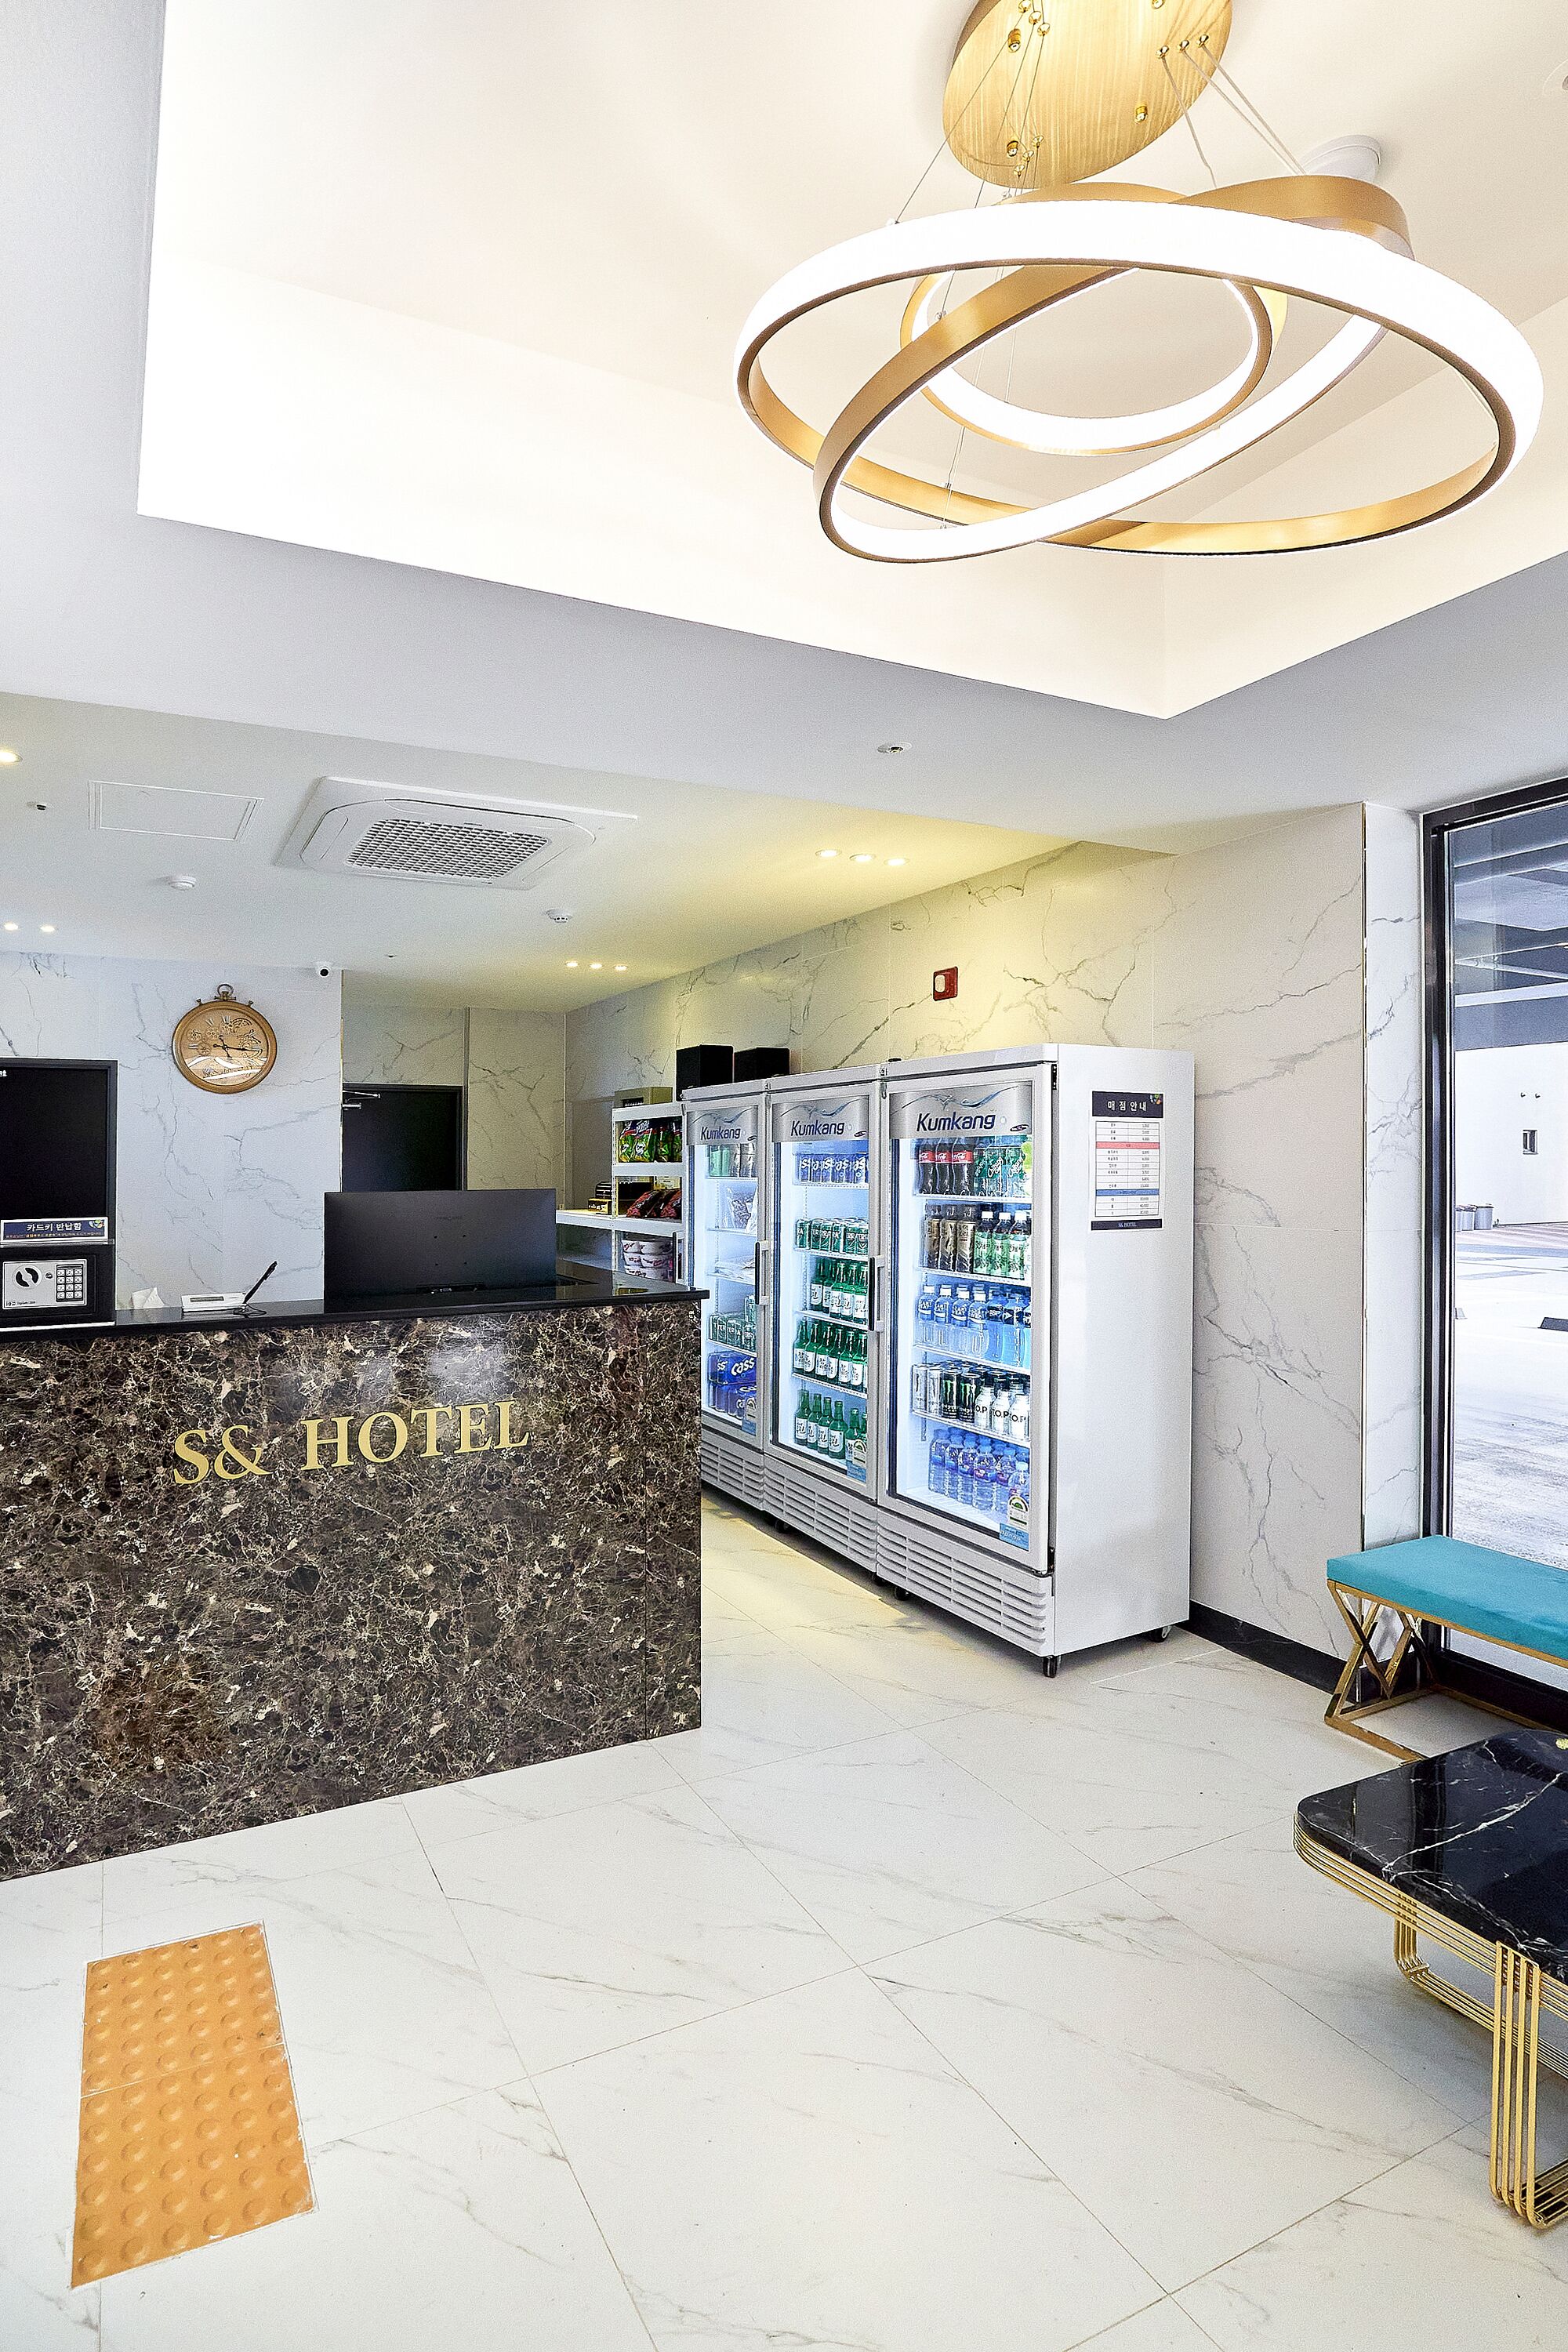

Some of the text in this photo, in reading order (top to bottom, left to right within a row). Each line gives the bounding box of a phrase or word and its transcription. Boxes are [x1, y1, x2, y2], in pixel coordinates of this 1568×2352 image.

[790, 1120, 845, 1136] Kumkang
[916, 1112, 996, 1132] Kumkang
[700, 1127, 741, 1141] Kumkang
[26, 1222, 82, 1232] 카드키 반납함
[173, 1399, 530, 1484] S& HOTEL
